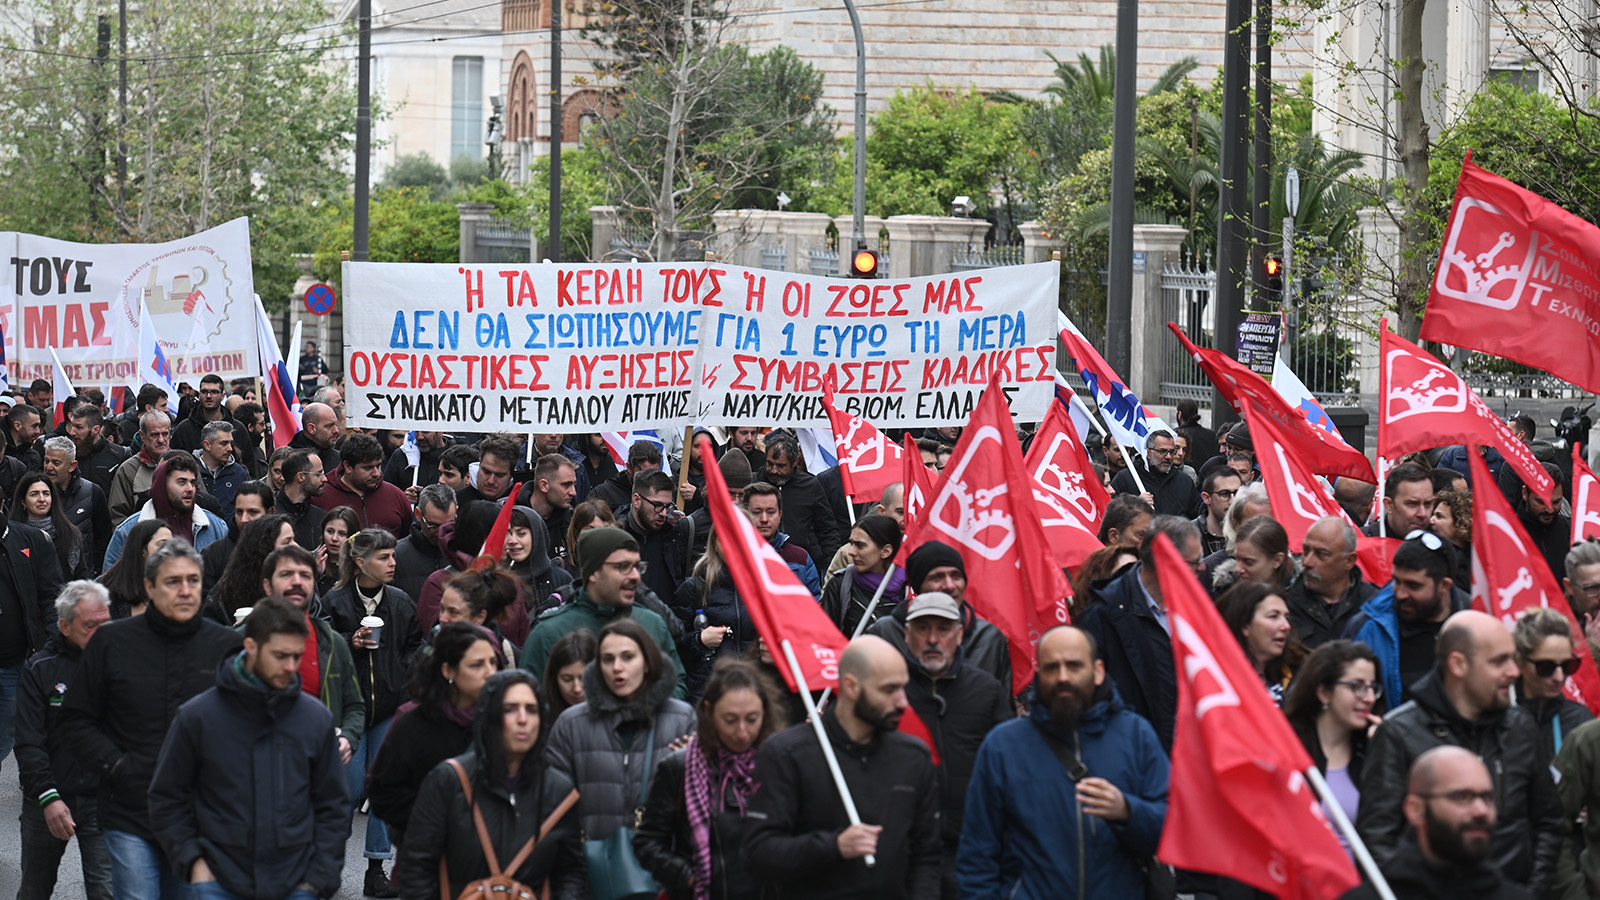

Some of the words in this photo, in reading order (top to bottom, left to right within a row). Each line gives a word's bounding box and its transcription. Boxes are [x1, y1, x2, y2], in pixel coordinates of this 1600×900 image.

[11, 257, 93, 296] ΤΟΥΣ
[499, 270, 538, 307] ΤΑ
[558, 268, 643, 307] ΚΕΡΔΗ
[659, 268, 727, 307] ΤΟΥΣ
[782, 280, 811, 318] ΟΙ
[825, 284, 912, 318] ΖΩΕΣ
[922, 276, 983, 314] ΜΑΣ
[25, 302, 112, 348] ΜΑΣ
[389, 310, 460, 351] ΔΕΝ
[475, 312, 511, 349] ΘΑ
[524, 309, 703, 350] ΣΙΩΠΗΣΟΥΜΕ
[715, 313, 761, 352] ΓΙΑ
[780, 321, 798, 357] 1
[813, 324, 888, 358] ΕΥΡΩ
[904, 320, 941, 354] ΤΗ
[957, 310, 1027, 352] ΜΕΡΑ
[9, 361, 83, 380] ΓΑΛΑΚΟΣ
[176, 357, 188, 375] &
[192, 353, 243, 374] ΠΟΤΩΝ
[350, 351, 551, 391] ΟΥΣΙΑΣΤΙΚΕΣ
[566, 349, 695, 390] ΑΥΞΗΣΕΙΣ
[729, 354, 910, 395] ΣΥΜΒΑΣΕΙΣ
[921, 345, 1056, 388] ΚΛΑΔΙΚΕΣ
[366, 392, 486, 423] ΣΥΝΔΙΚΑΤΟ
[500, 395, 614, 425] ΜΕΤΑΛΛΟΥ
[621, 390, 692, 423] ΑΤΤΙΚΗΣ
[722, 392, 829, 421] ΝΑΥΠ/ΚΗΣ
[845, 395, 906, 420] ΒΙΟΜ.
[916, 386, 1020, 420] ΕΛΛΑΣ
